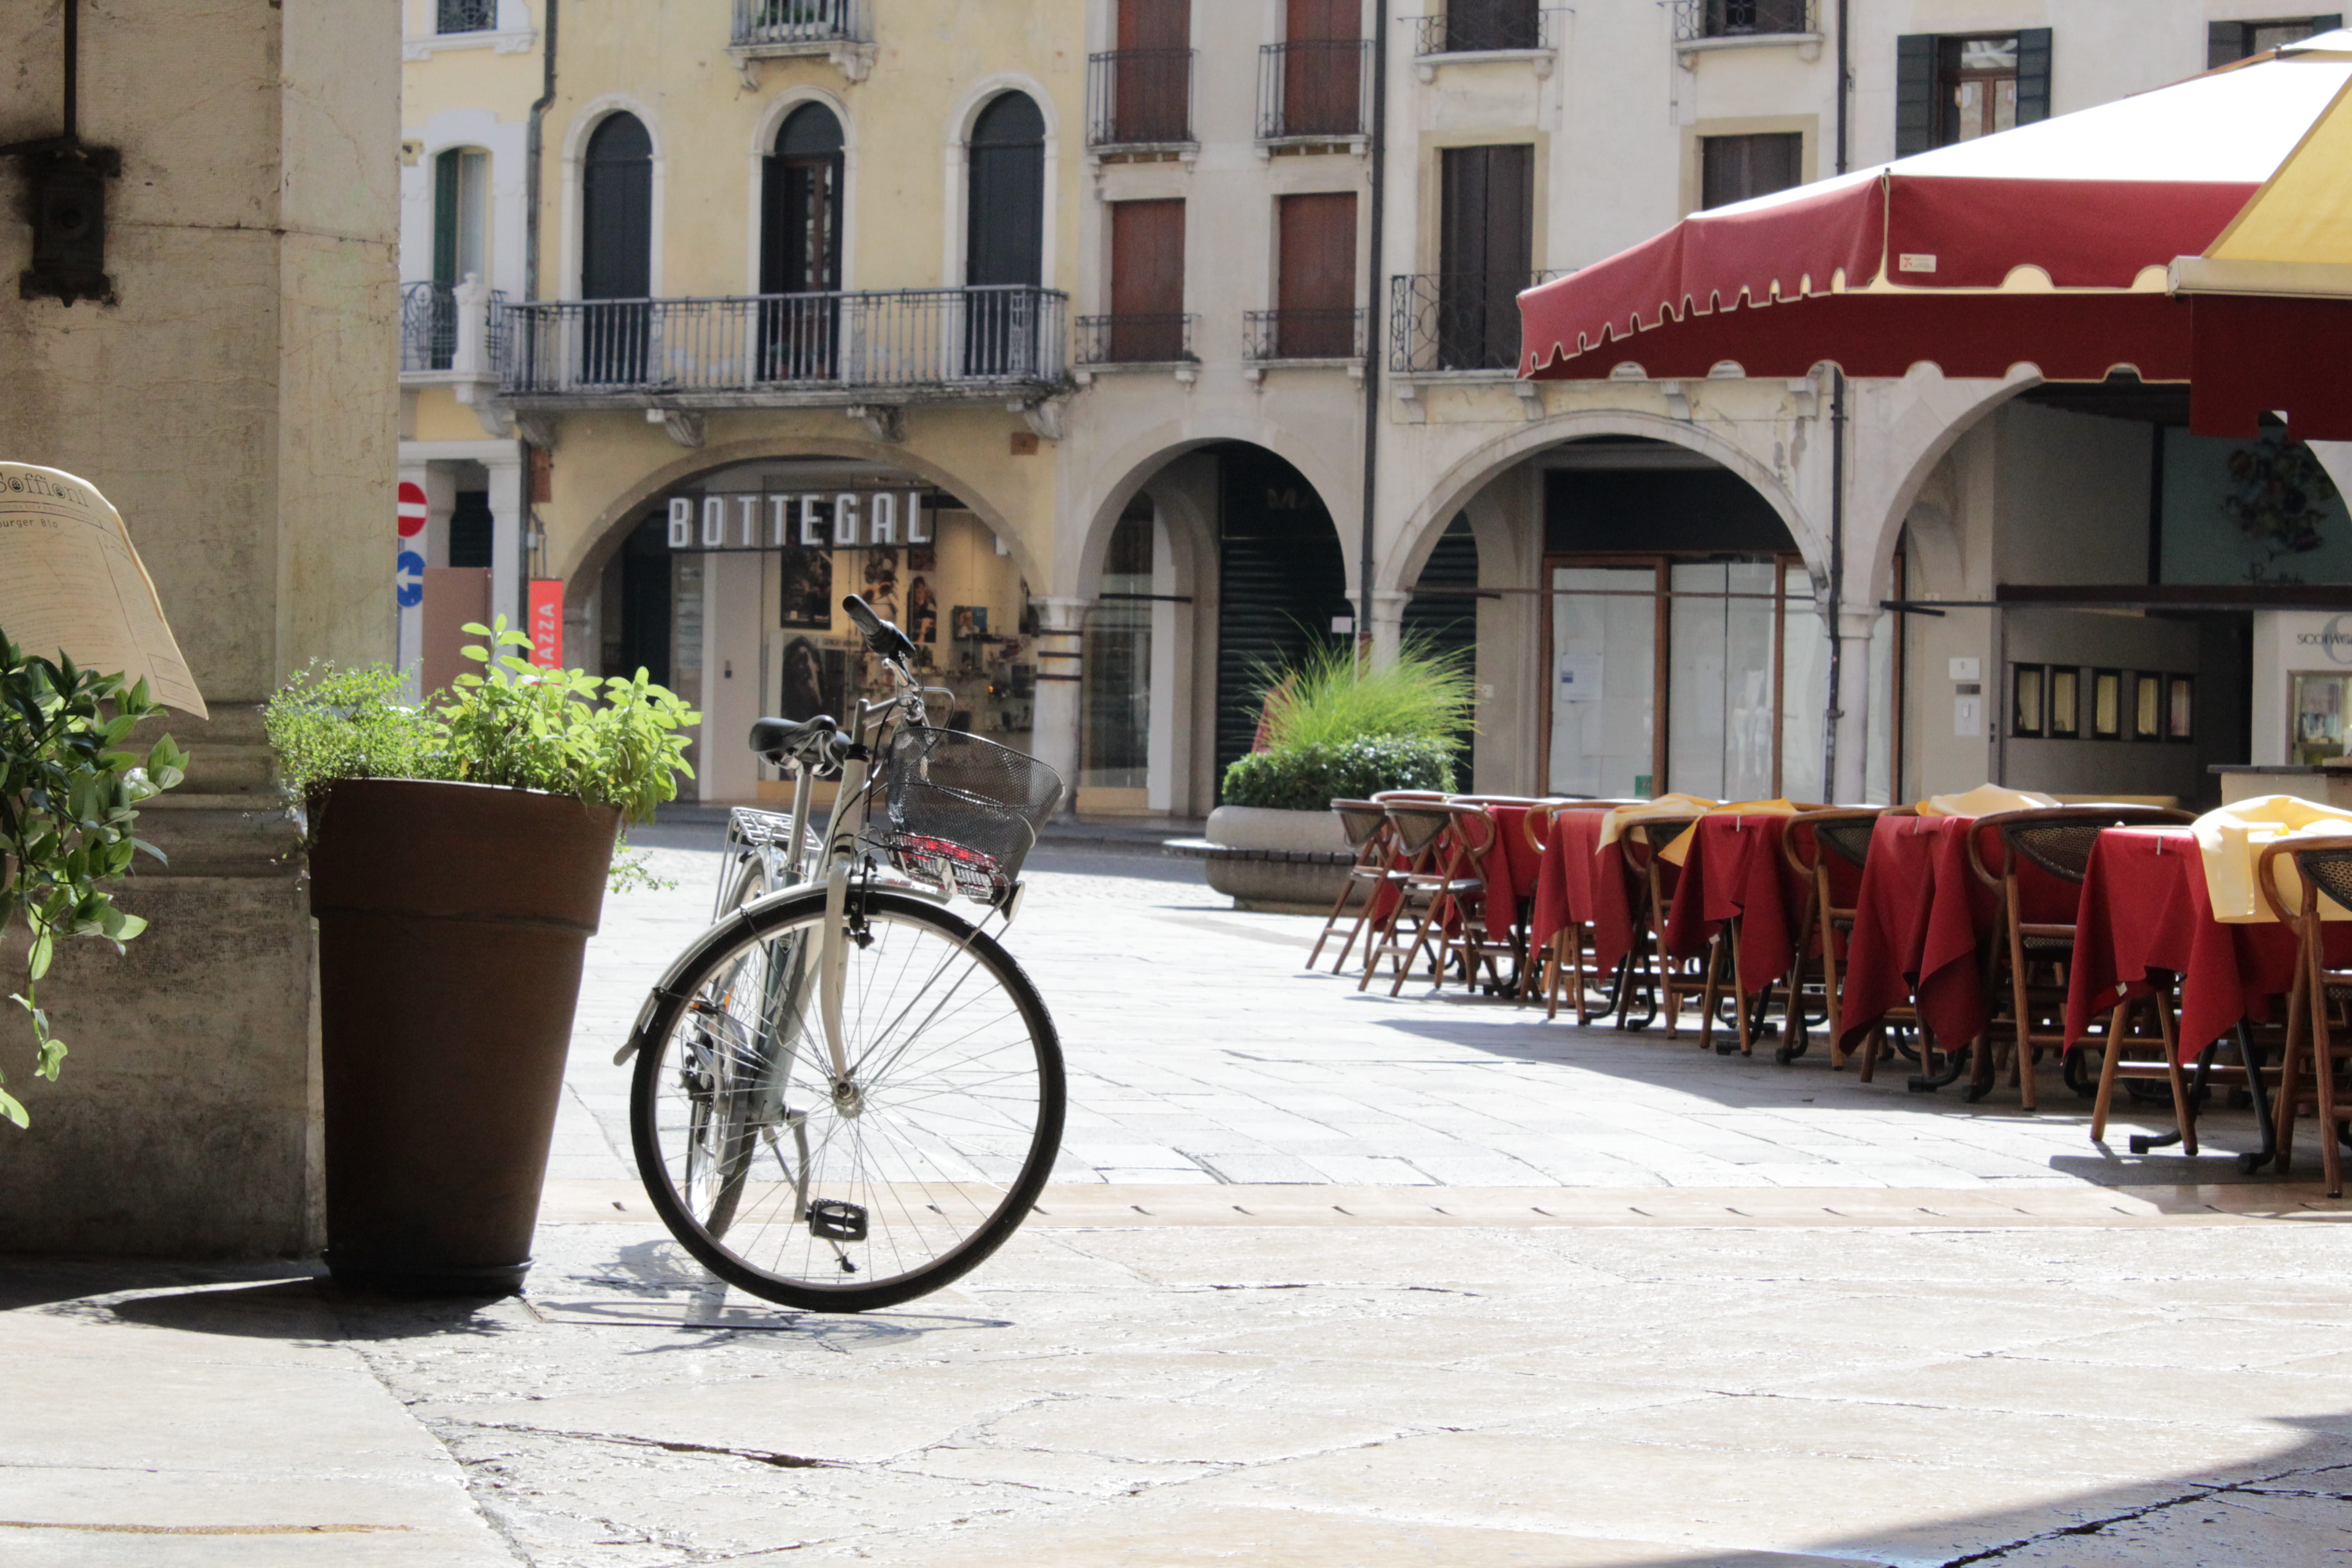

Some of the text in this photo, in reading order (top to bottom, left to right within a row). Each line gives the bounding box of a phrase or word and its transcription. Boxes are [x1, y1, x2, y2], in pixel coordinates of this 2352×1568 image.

[40, 519, 58, 528] Bio
[668, 492, 930, 548] BOTTEGAL
[2297, 633, 2352, 645] SCOPAG
